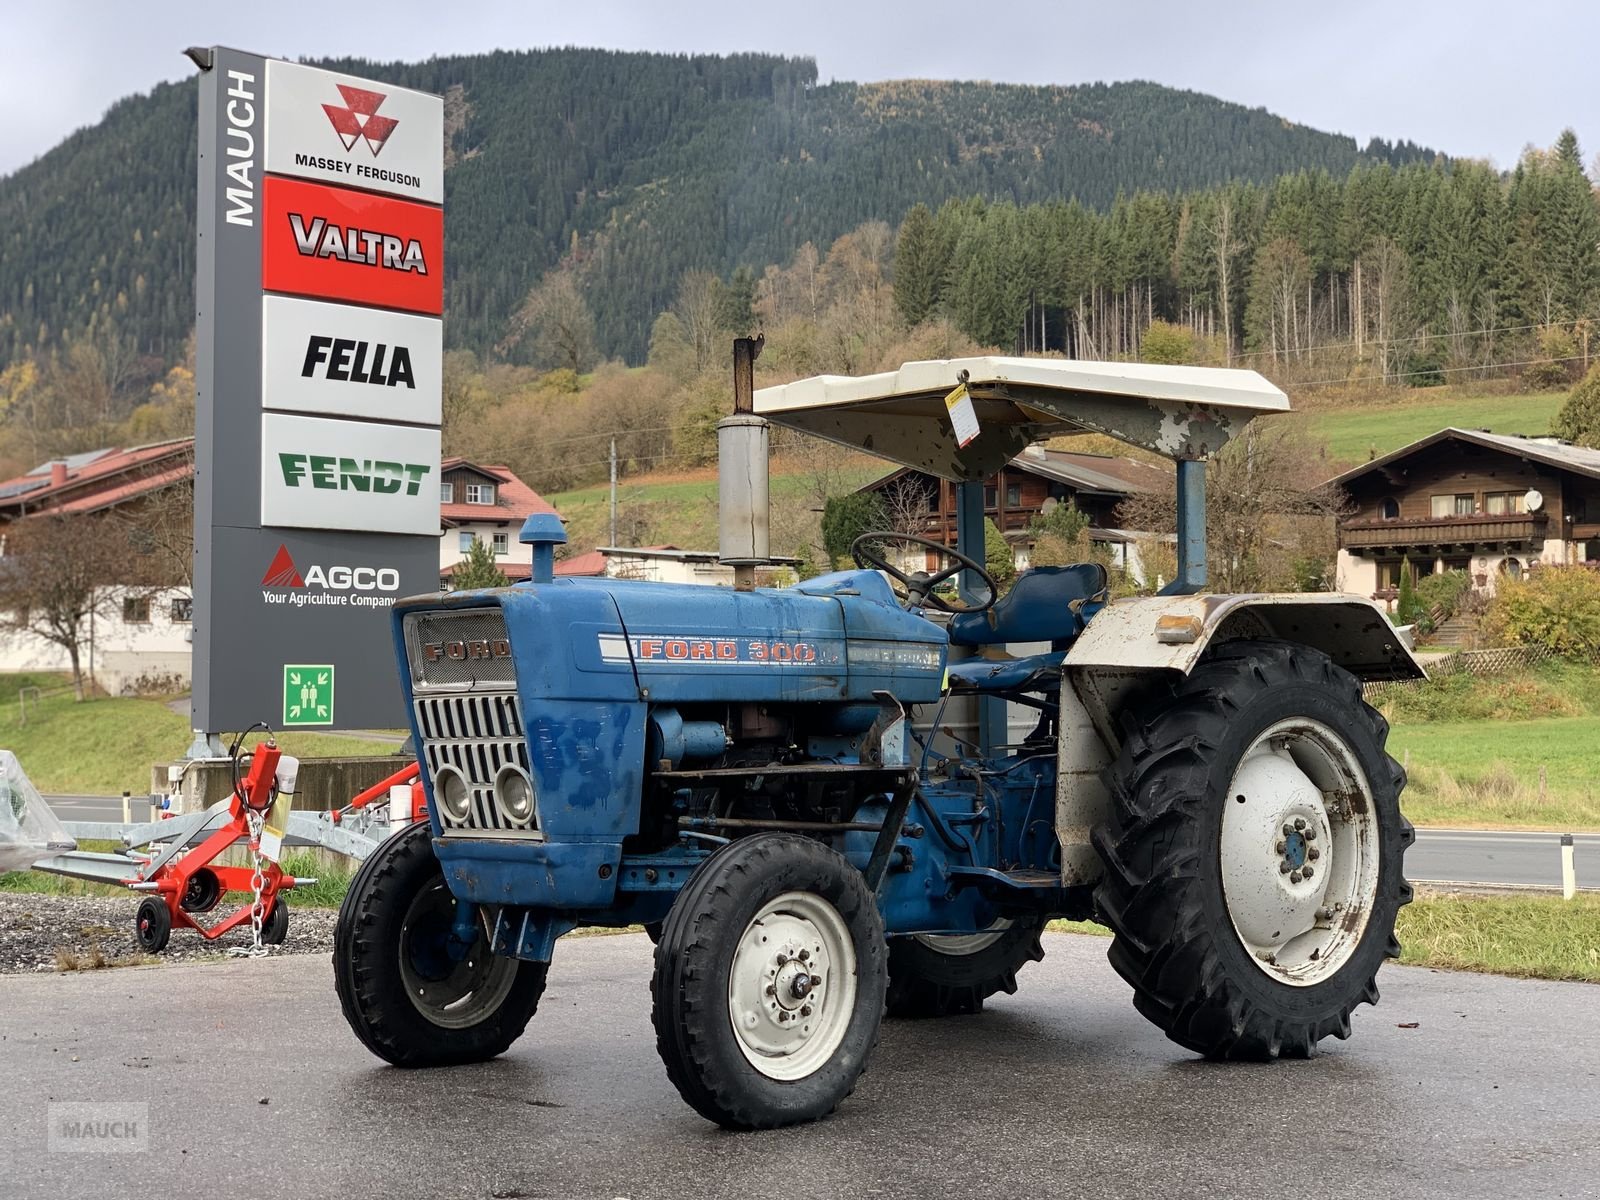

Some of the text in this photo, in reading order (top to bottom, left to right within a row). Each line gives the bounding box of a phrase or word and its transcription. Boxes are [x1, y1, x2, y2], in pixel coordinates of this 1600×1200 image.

[226, 70, 255, 227] MAUCH
[295, 153, 421, 188] MASSEY FERGUSON
[287, 212, 428, 276] VALTRA
[301, 335, 416, 389] FELLA
[278, 452, 431, 496] FENDT
[304, 565, 400, 591] AGCO
[262, 591, 287, 604] Your
[289, 592, 348, 607] Agriculture
[425, 640, 511, 661] FORD
[639, 640, 737, 660] FORD
